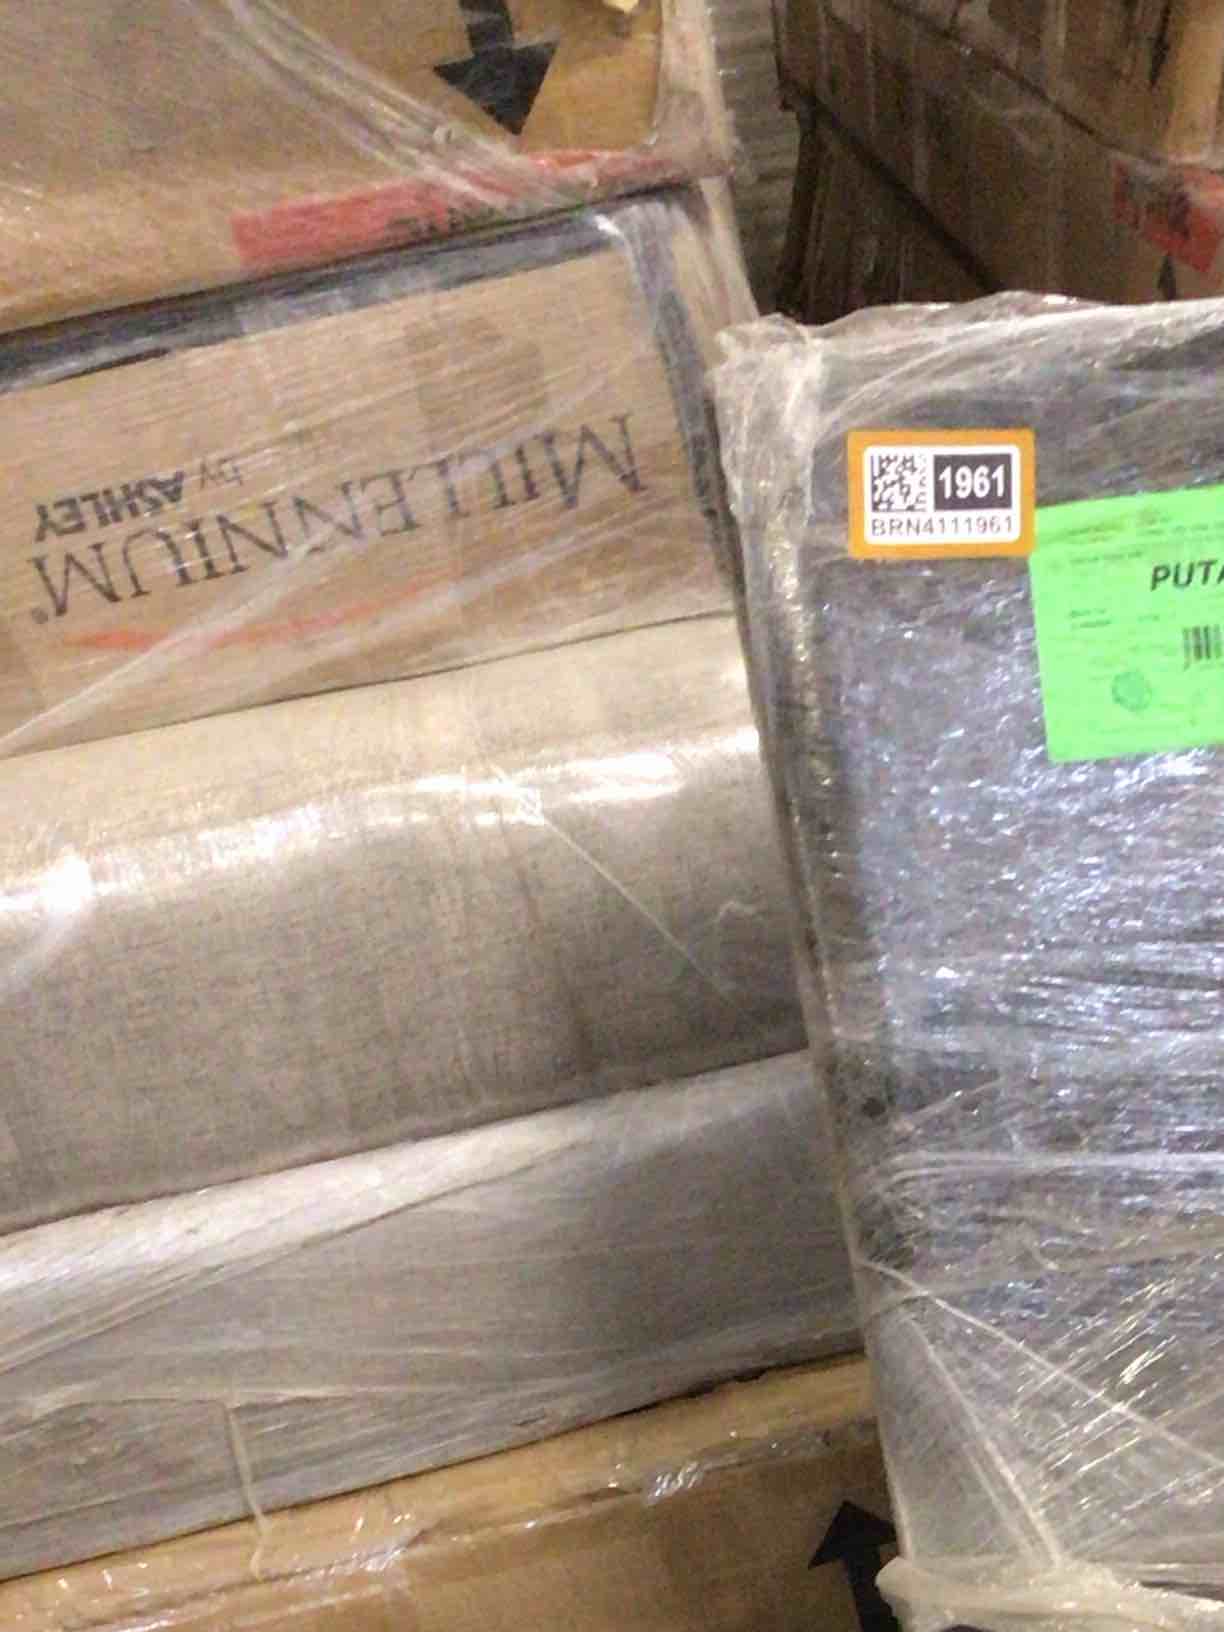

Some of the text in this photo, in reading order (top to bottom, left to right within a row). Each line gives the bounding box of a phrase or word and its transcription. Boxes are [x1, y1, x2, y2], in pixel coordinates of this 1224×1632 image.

[34, 470, 186, 542] ASHLEY
[938, 464, 1006, 500] 1961
[27, 412, 647, 617] MILLENNIUM
[871, 515, 1013, 537] BRN4111961
